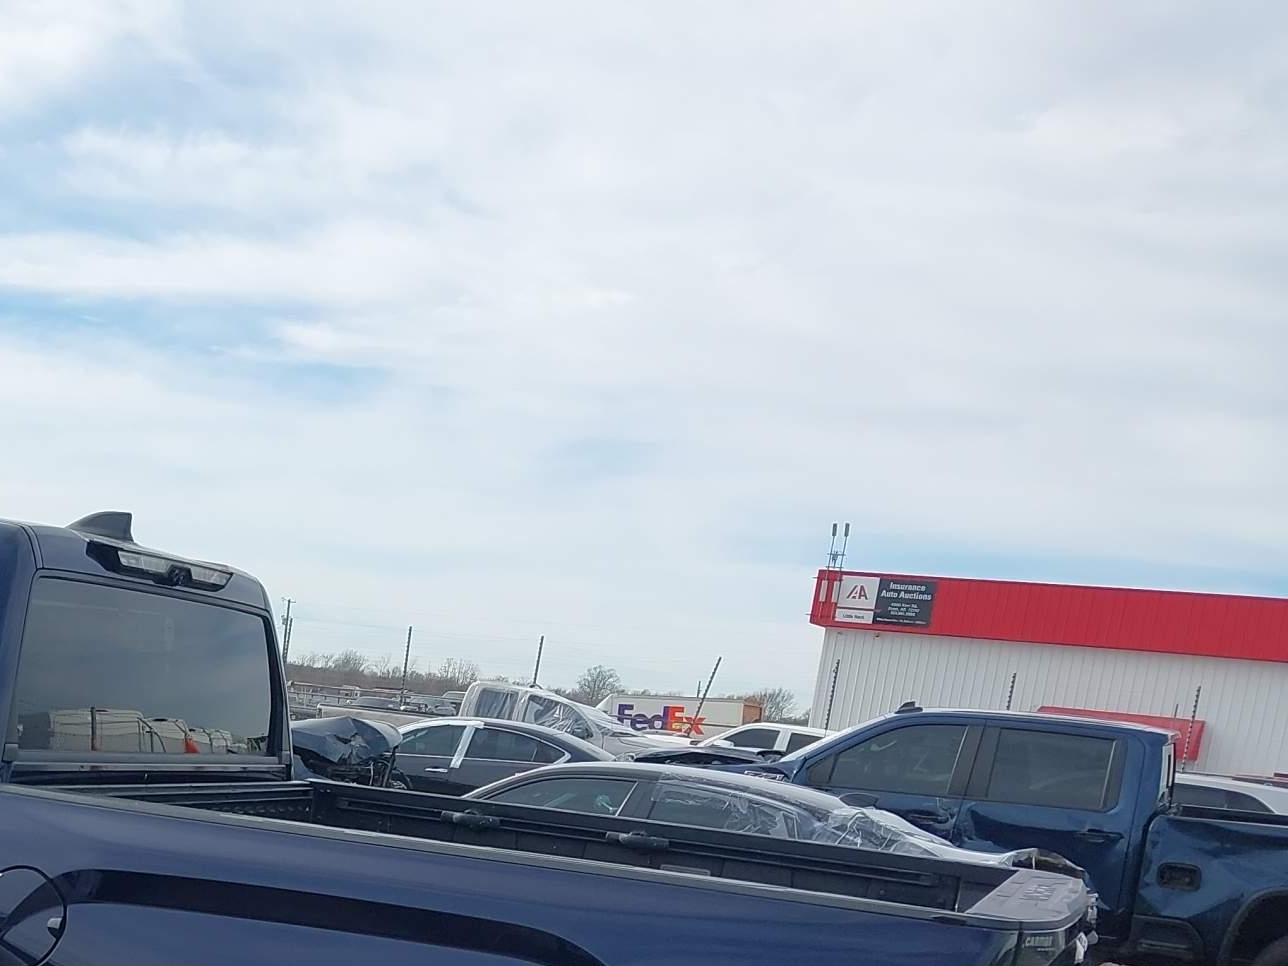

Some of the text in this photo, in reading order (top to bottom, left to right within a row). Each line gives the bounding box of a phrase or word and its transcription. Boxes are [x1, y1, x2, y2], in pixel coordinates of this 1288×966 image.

[889, 581, 926, 592] Insurance
[881, 590, 932, 601] Auto Auctions
[617, 703, 706, 735] FedEx
